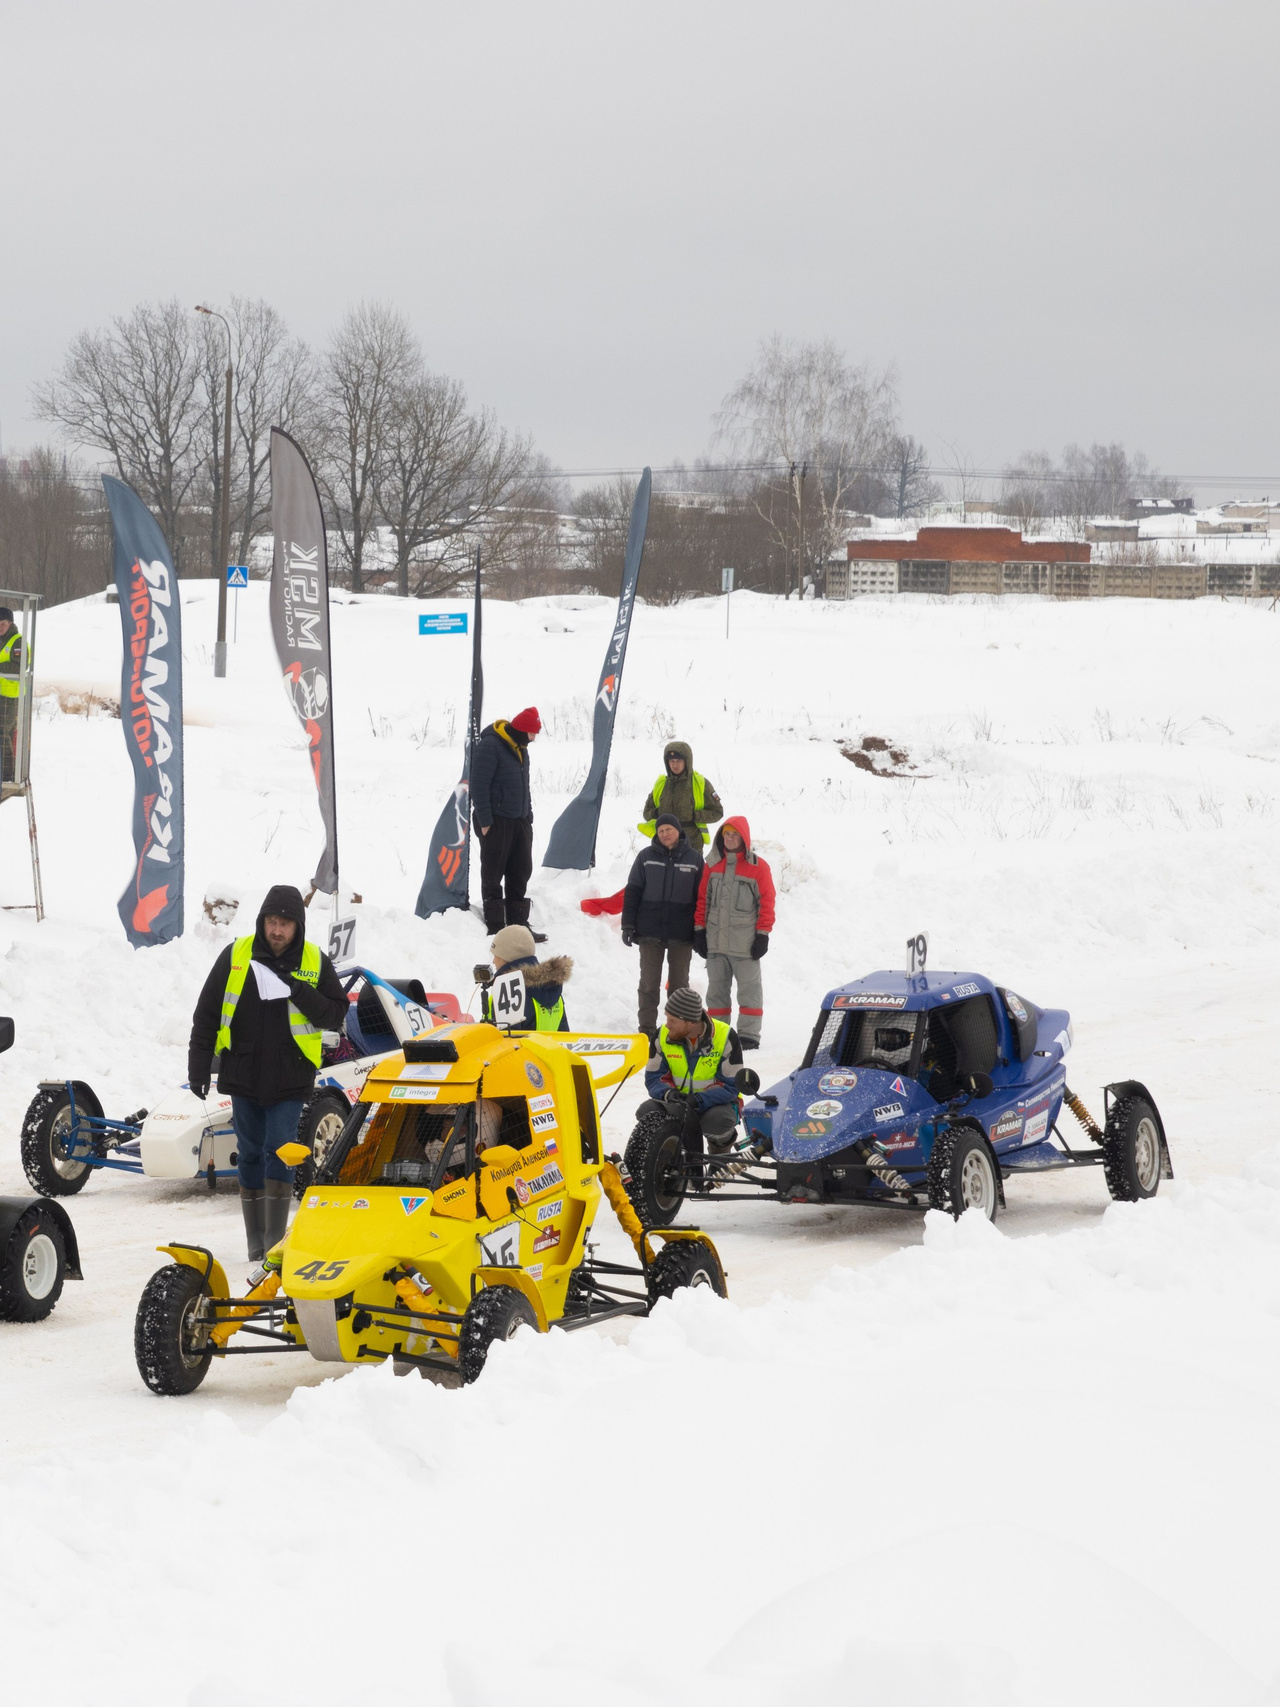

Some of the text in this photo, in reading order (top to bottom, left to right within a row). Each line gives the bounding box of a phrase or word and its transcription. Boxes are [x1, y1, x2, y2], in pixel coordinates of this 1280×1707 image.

[328, 919, 356, 961] 57
[907, 934, 927, 973] 79
[297, 969, 319, 979] RUST
[498, 978, 522, 1015] 45
[955, 984, 980, 996] RUSTA
[848, 996, 905, 1005] KRAMAR
[407, 1008, 425, 1031] 57
[562, 1043, 629, 1051] YAMA
[393, 1088, 436, 1097] IP integra
[874, 1103, 901, 1117] NWB
[532, 1114, 554, 1126] NWB
[996, 1118, 1022, 1135] KRAMAR
[490, 1146, 549, 1182] Комаров Алексей
[527, 1168, 563, 1193] TAKAYAMA
[537, 1200, 562, 1221] RUSTA
[293, 1260, 351, 1281] 45
